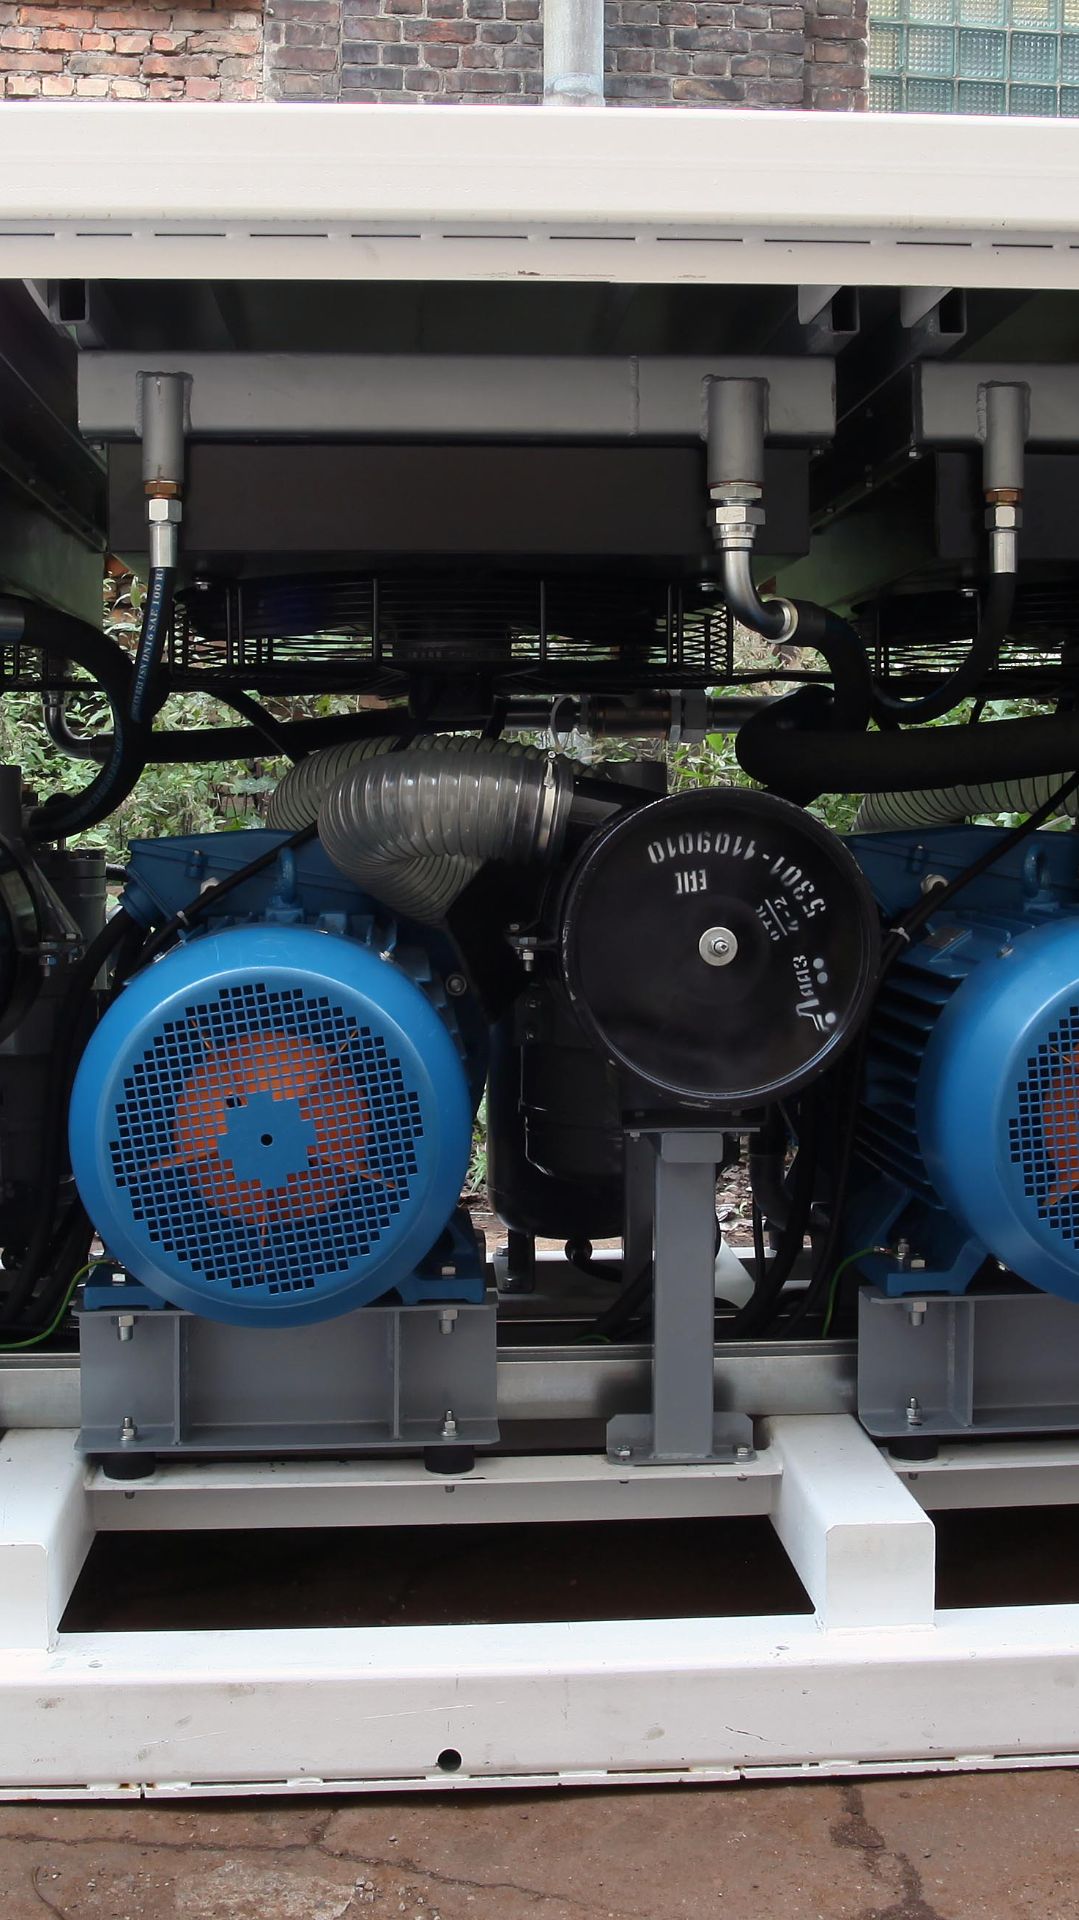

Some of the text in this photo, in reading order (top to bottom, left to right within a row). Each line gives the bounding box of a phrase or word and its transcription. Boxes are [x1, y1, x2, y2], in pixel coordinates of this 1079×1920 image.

[151, 584, 162, 606] 100
[148, 608, 159, 631] SAE
[143, 633, 154, 662] DN16
